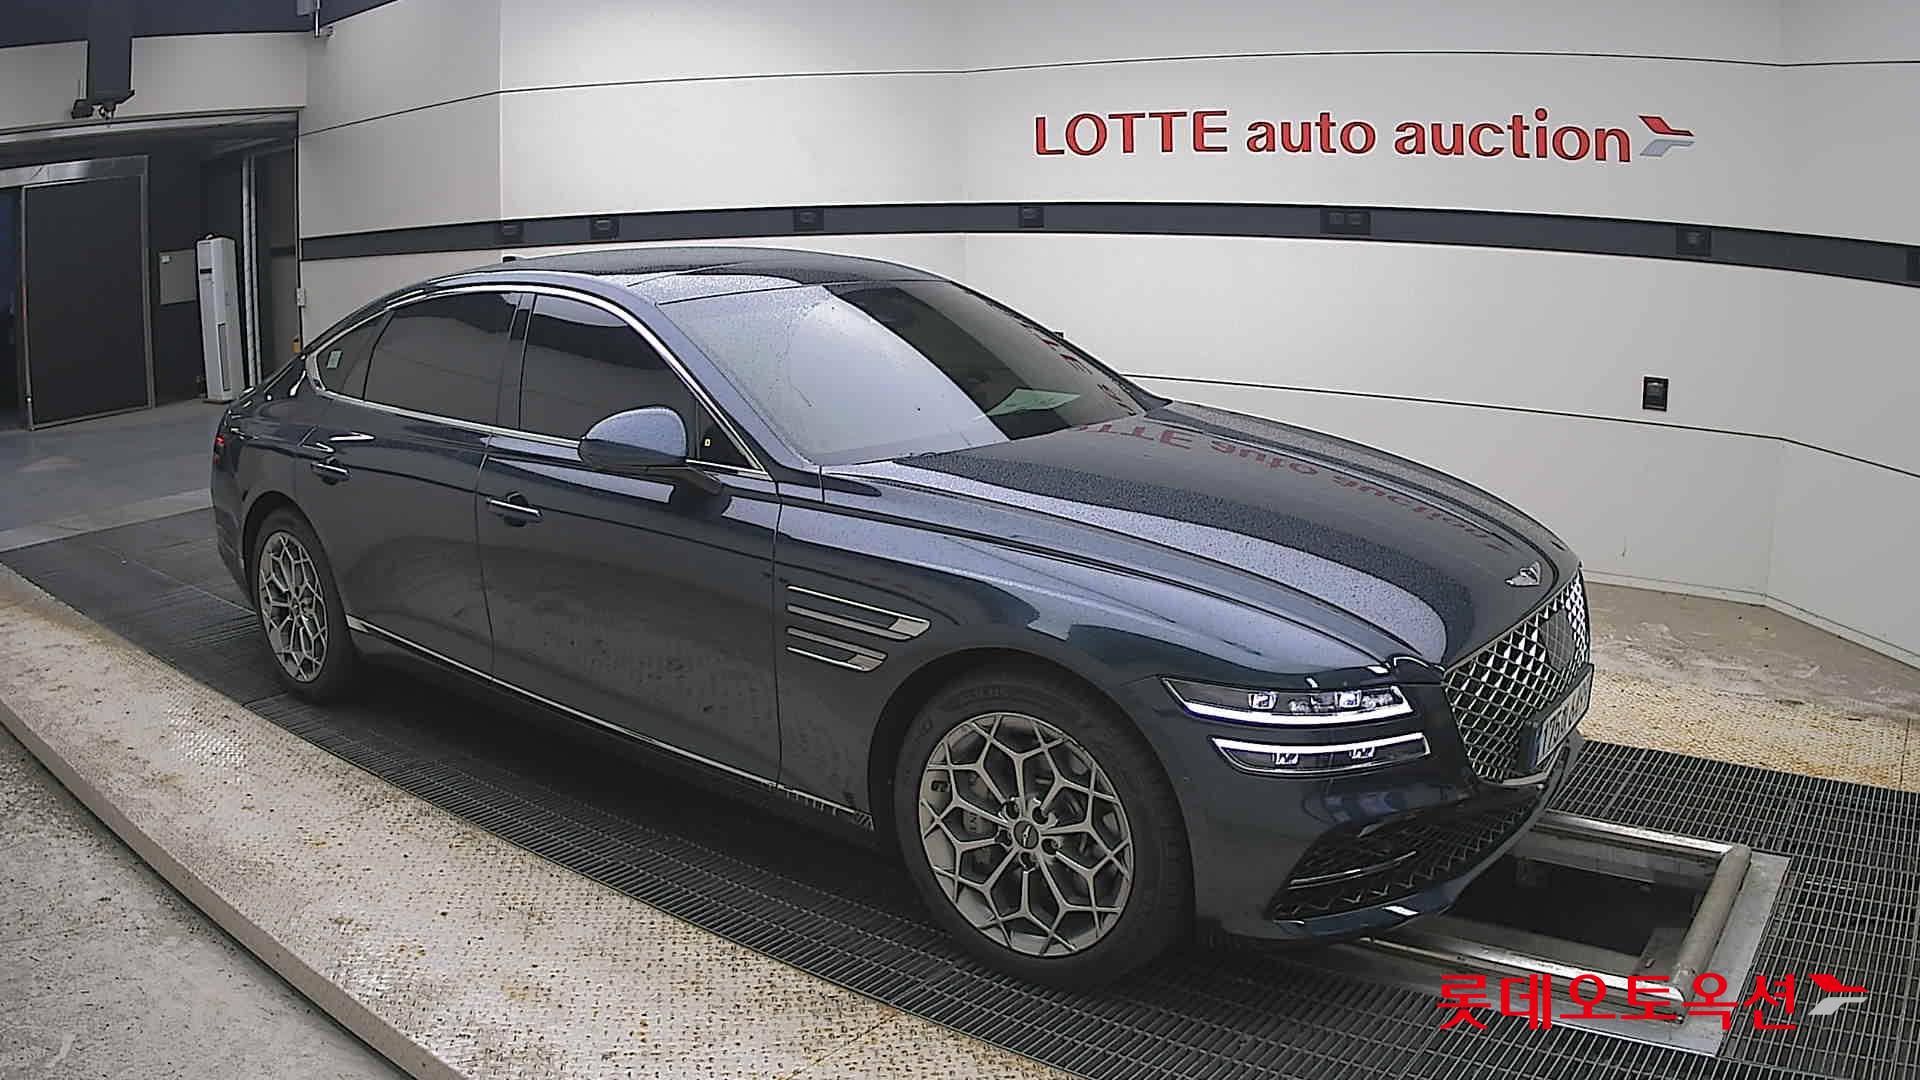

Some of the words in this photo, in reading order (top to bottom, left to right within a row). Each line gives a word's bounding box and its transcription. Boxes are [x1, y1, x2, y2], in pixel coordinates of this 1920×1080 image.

[1034, 109, 1228, 156] LOTTE
[1246, 111, 1377, 154] auto
[1394, 108, 1632, 163] auction
